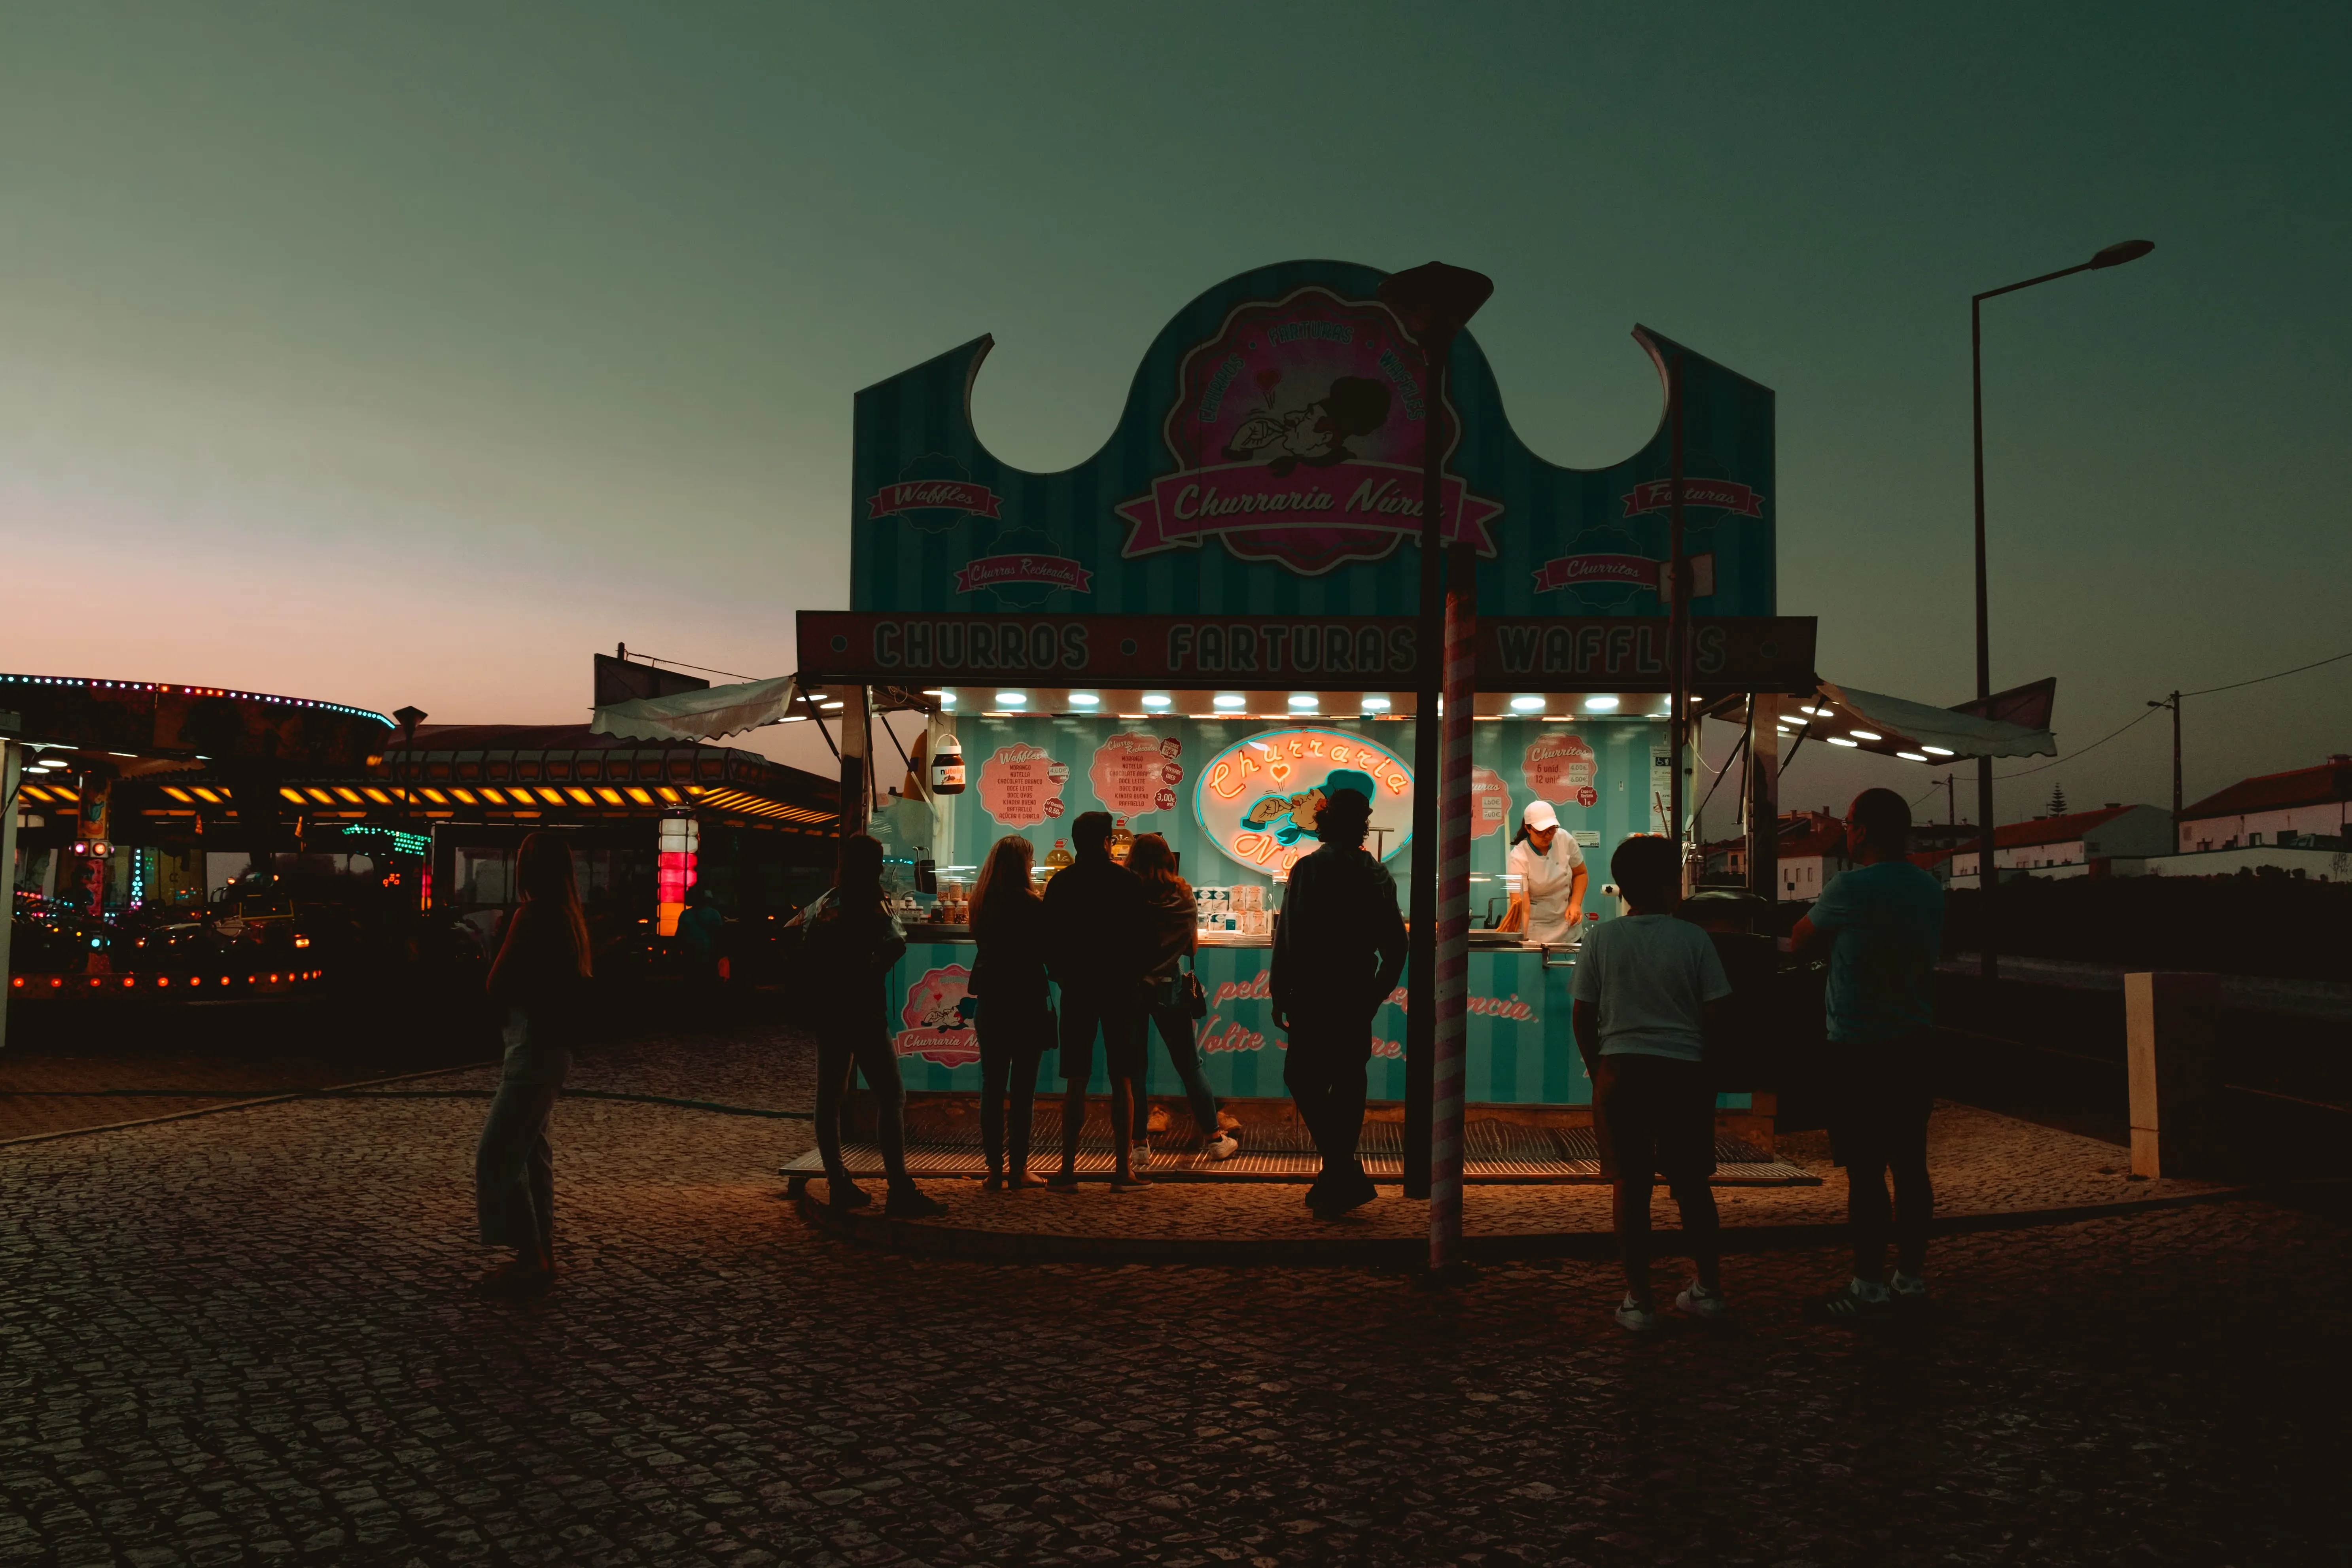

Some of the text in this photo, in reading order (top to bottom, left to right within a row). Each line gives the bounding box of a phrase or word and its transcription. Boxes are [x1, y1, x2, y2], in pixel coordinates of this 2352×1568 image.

[1197, 321, 1426, 423] CHURROS FARTURAS WAFFLES
[895, 482, 976, 505] Waffles
[1173, 478, 1446, 520] Churraria Núri
[1648, 483, 1737, 504] Faturas
[971, 559, 1075, 582] Churros Recheados
[1567, 560, 1640, 578] Churritos
[872, 621, 1090, 670] CHURROS
[1167, 624, 1417, 673] FARTURAS
[1108, 740, 1134, 750] Churros
[1125, 744, 1158, 754] Recheados
[1531, 747, 1589, 762] Churritos
[1000, 750, 1042, 764] Waffles
[1210, 738, 1408, 799] Churraria
[1535, 775, 1543, 783] 12
[904, 1033, 961, 1048] Churraria
